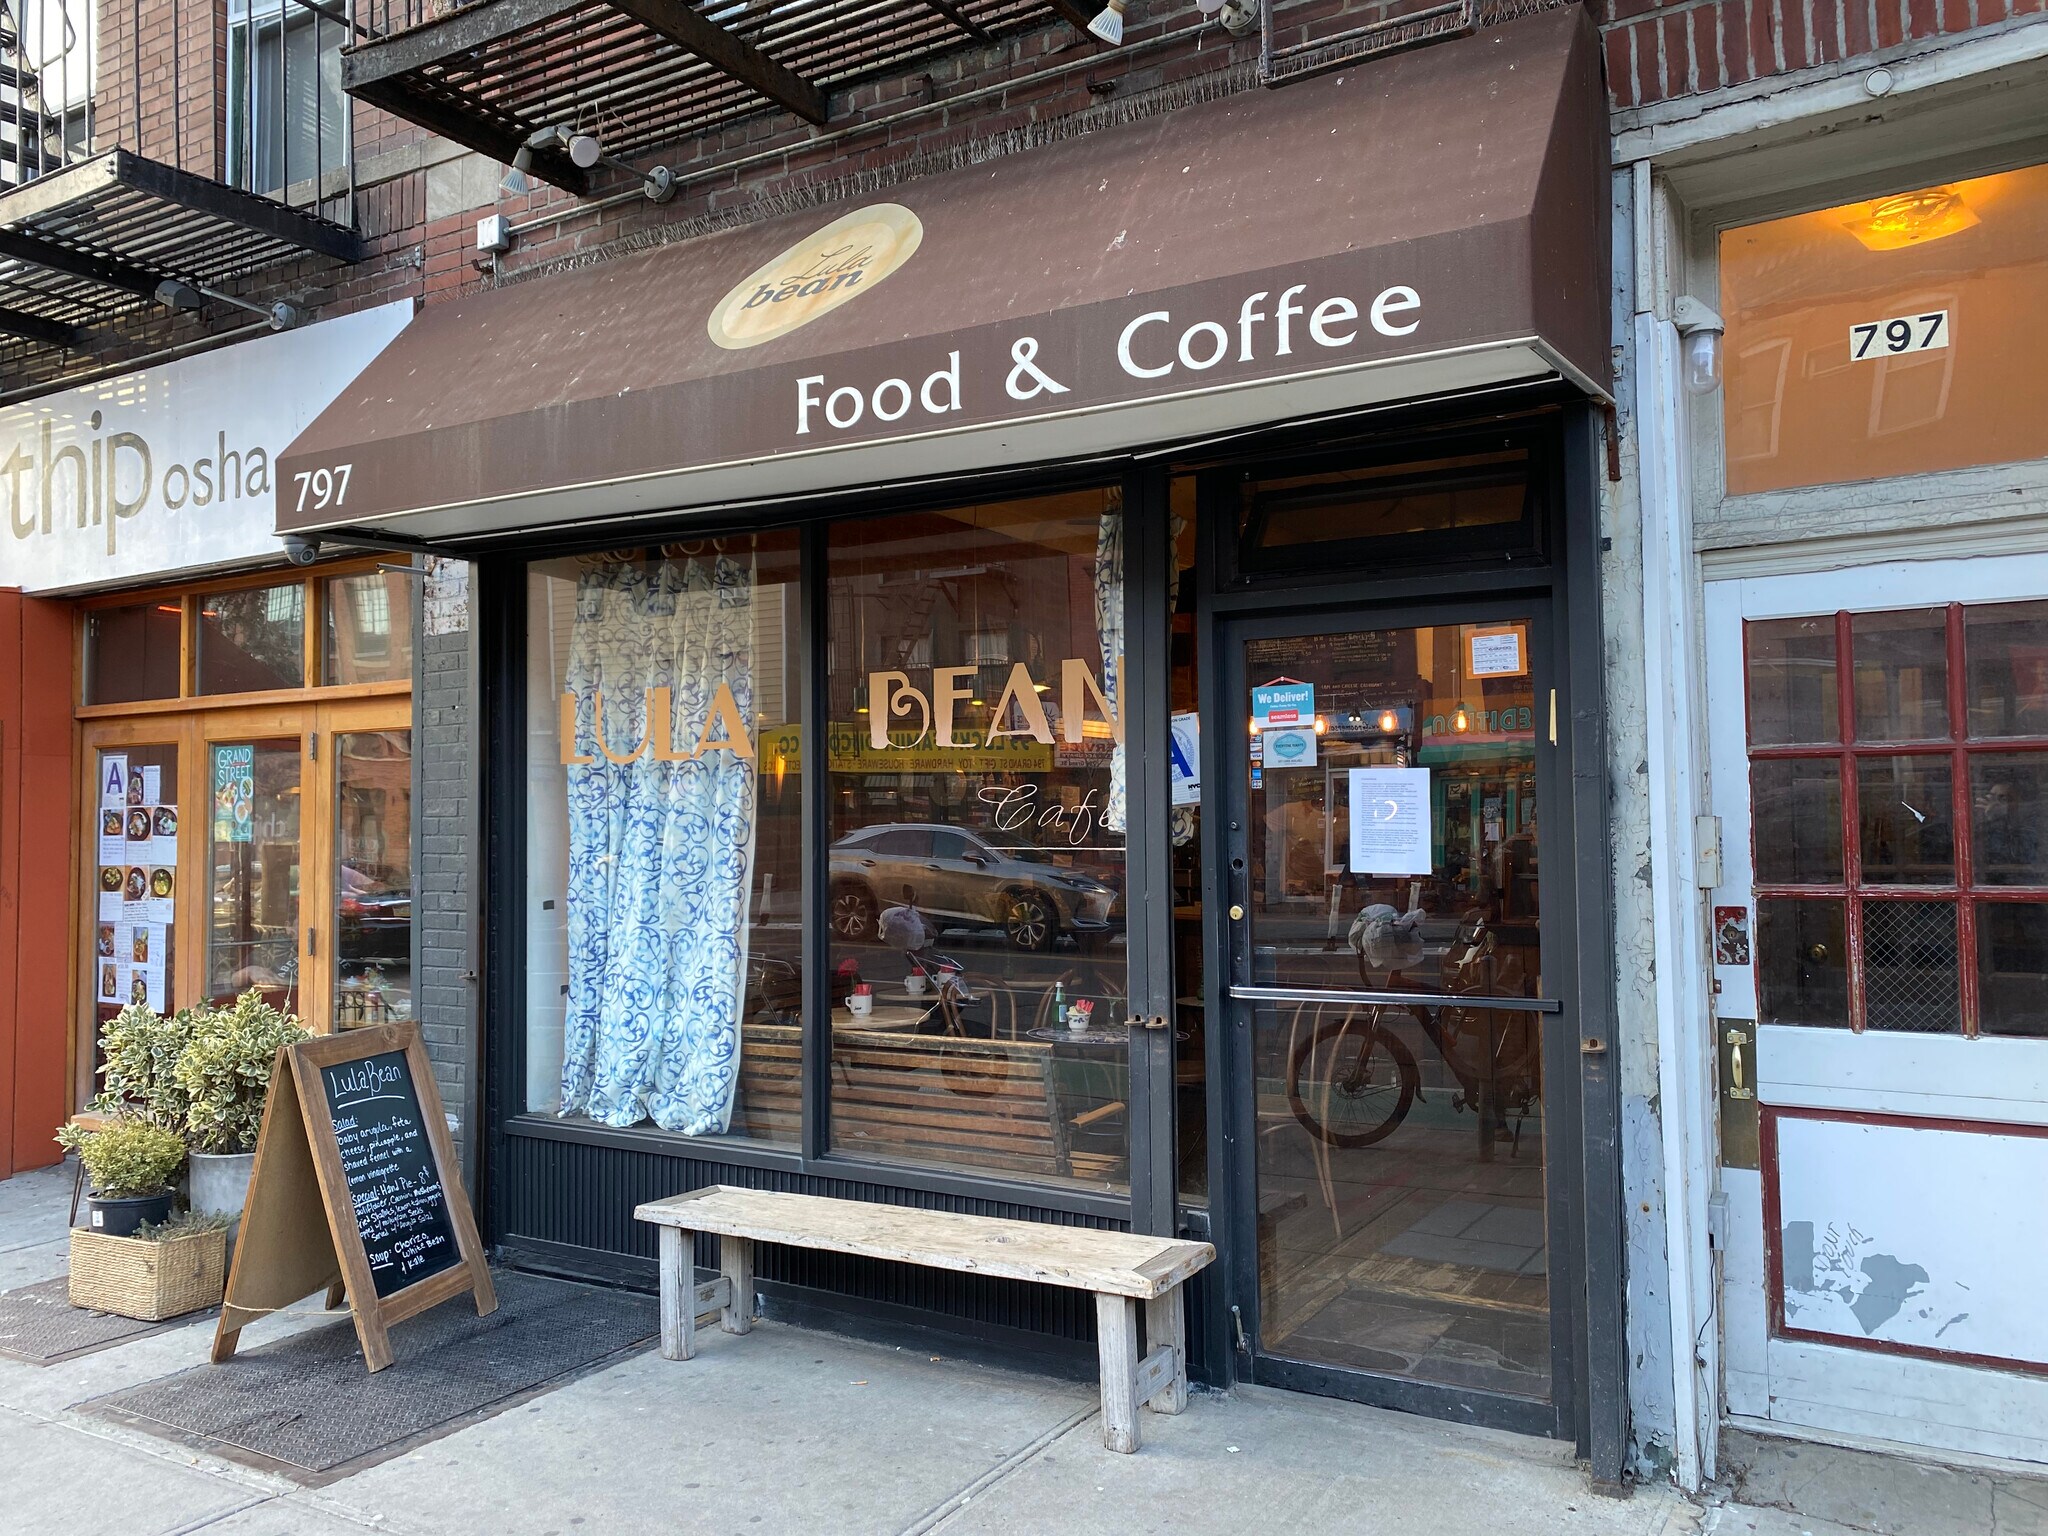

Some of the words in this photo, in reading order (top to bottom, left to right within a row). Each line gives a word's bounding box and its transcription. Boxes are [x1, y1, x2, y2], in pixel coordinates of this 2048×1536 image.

[781, 244, 873, 286] Lula
[740, 269, 865, 310] bean
[1853, 313, 1944, 358] 797
[795, 350, 962, 434] Food
[1005, 336, 1070, 400] &
[1117, 284, 1421, 378] Coffee
[0, 409, 153, 556] thip
[162, 430, 270, 510] osha
[293, 464, 352, 512] 797
[868, 656, 1125, 749] BEAN
[1257, 693, 1272, 704] We
[1273, 691, 1309, 703] Deliver!
[560, 682, 755, 765] LULA
[218, 748, 251, 769] GRAND
[218, 765, 251, 786] STREET
[106, 762, 123, 793] A
[336, 1133, 360, 1145] baby
[391, 1115, 411, 1127] feta
[404, 1128, 418, 1139] and
[343, 1156, 369, 1172] shaved
[380, 1180, 400, 1195] Hand
